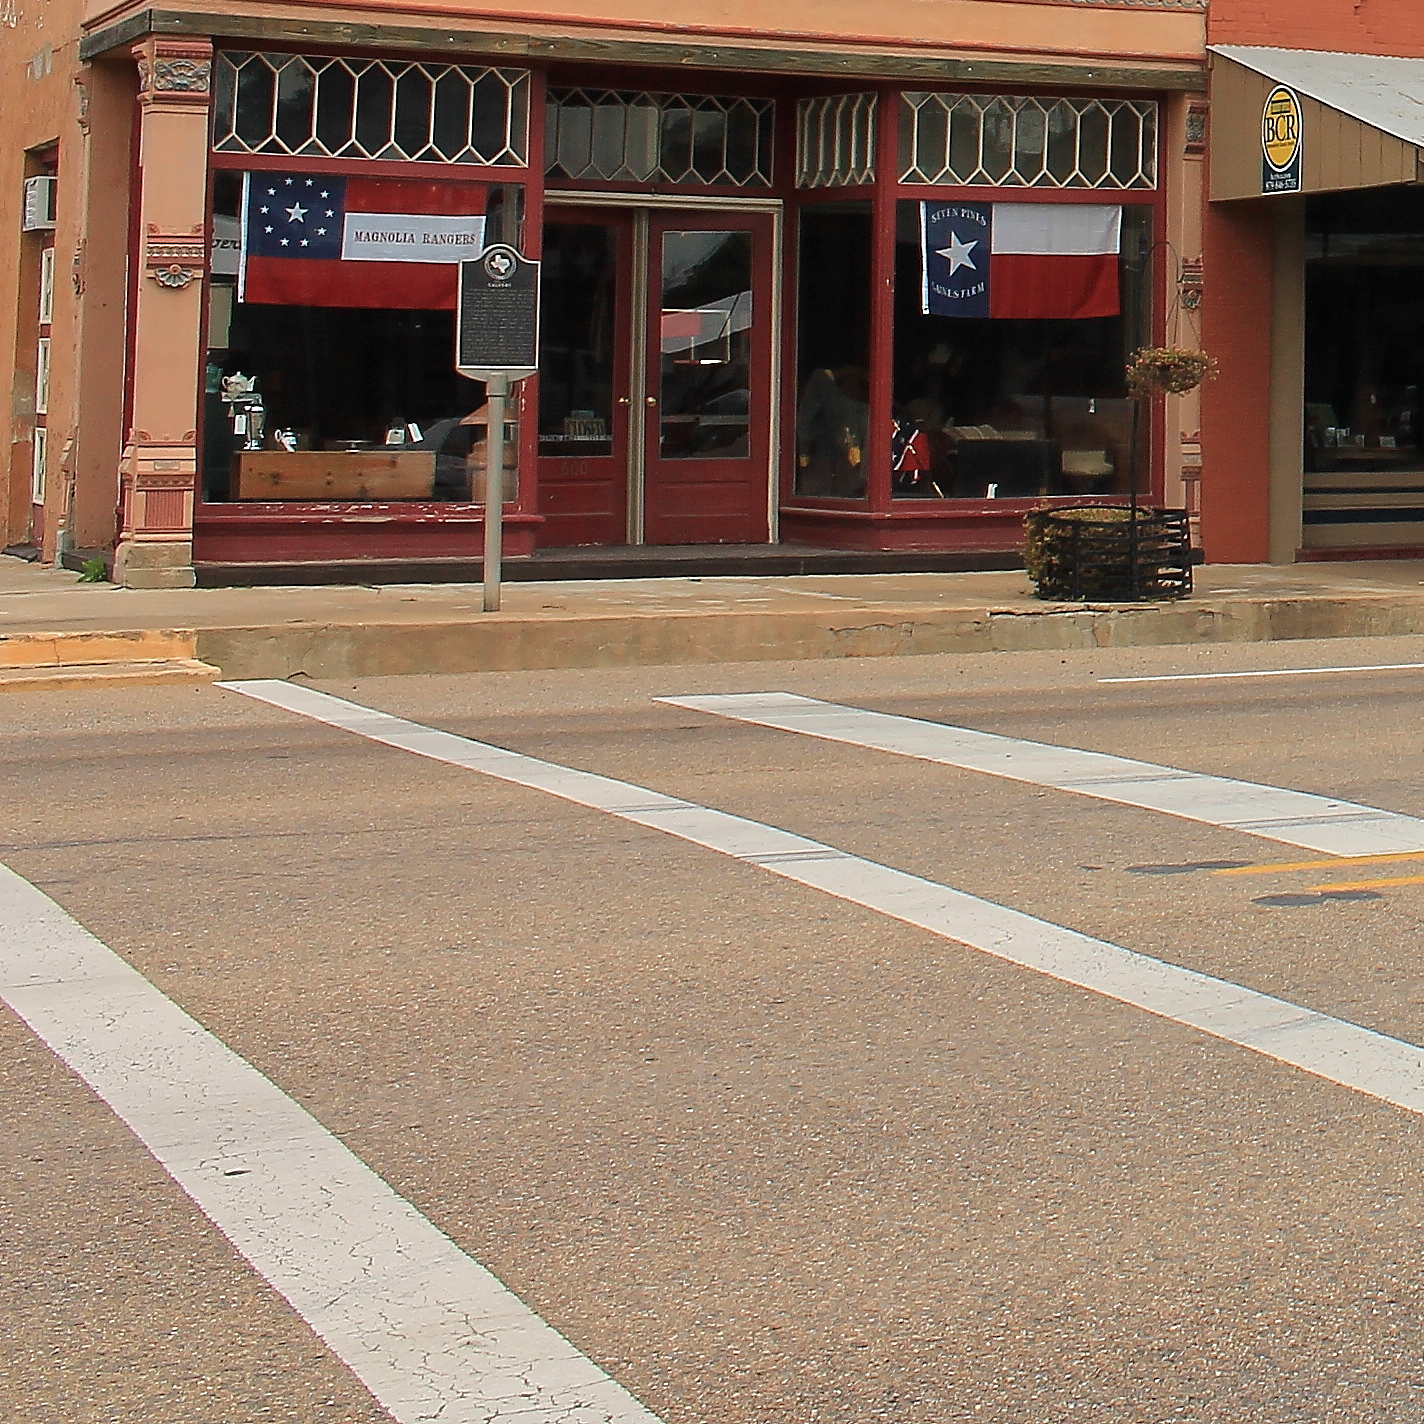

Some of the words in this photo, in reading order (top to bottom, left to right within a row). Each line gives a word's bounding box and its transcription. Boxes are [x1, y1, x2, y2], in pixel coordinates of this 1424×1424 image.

[1265, 114, 1297, 143] BCR
[353, 229, 416, 245] MAGNOLIA
[421, 231, 477, 246] RANGERS
